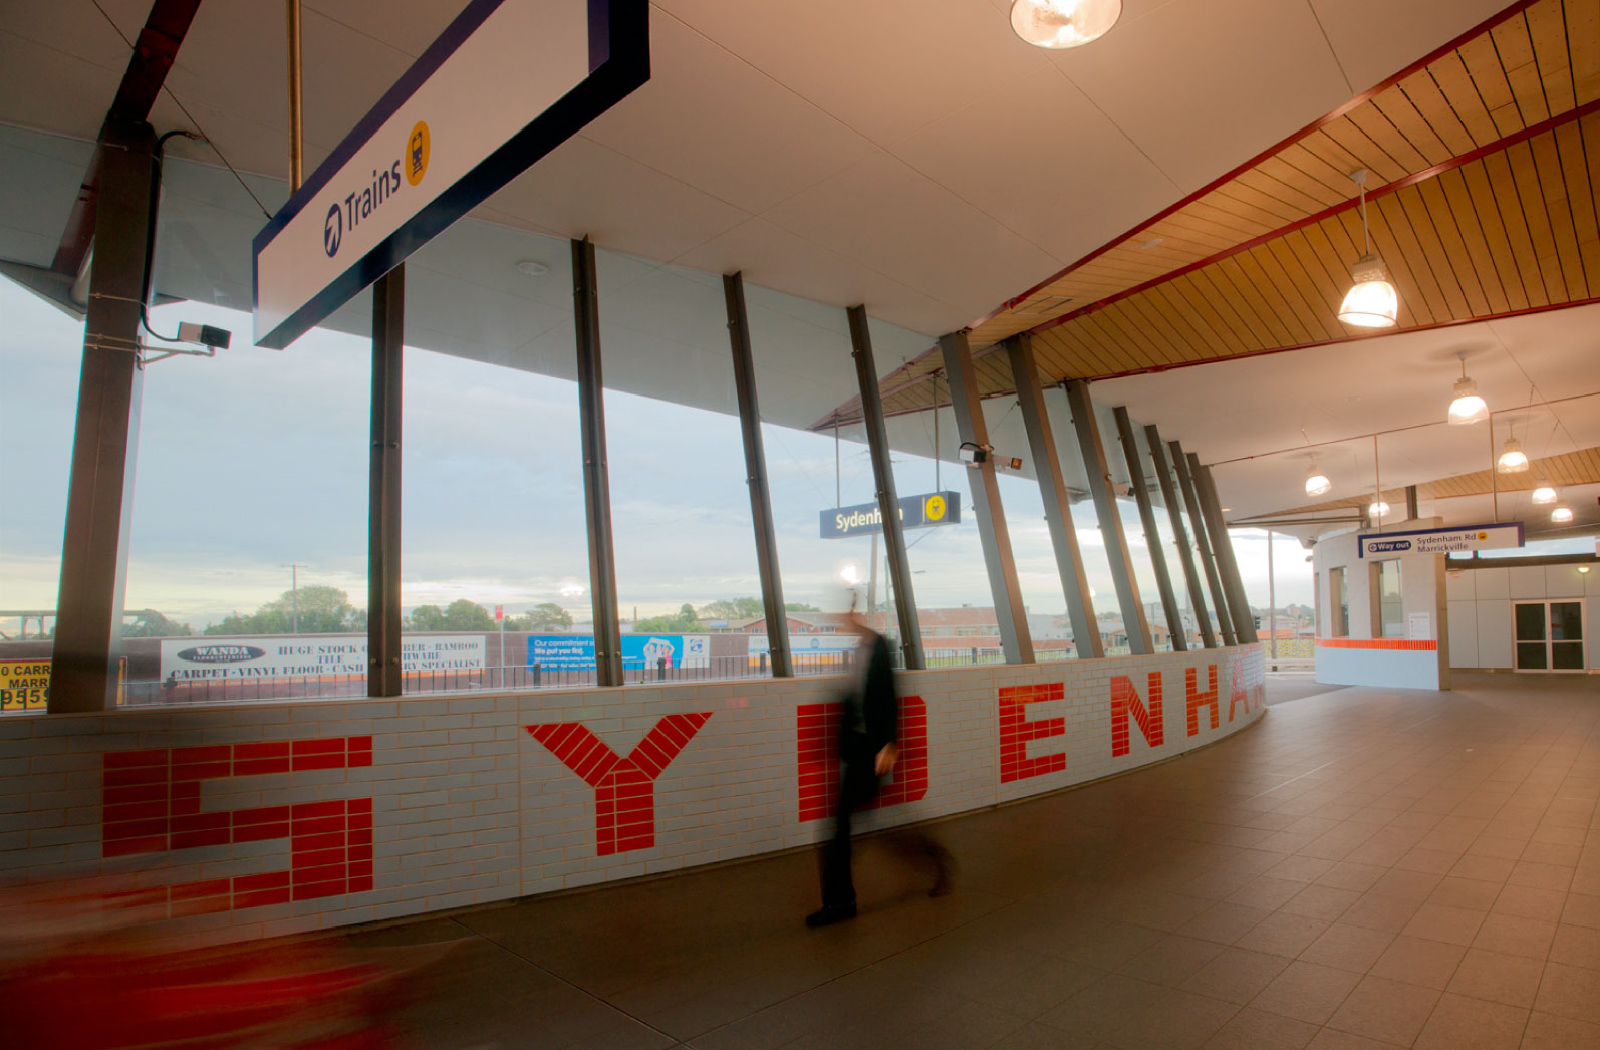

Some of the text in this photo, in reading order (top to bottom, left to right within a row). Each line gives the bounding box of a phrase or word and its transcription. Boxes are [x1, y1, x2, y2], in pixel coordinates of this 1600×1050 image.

[344, 159, 402, 232] Trains
[835, 507, 904, 532] Sydenh
[1416, 532, 1477, 545] Sydenham Rd
[1377, 541, 1410, 551] Way out
[1417, 543, 1469, 553] Marrickville
[195, 646, 249, 656] WANDA
[171, 668, 231, 679] CARPET
[238, 666, 279, 676] VINYL
[283, 664, 323, 675] FLOOR
[332, 663, 364, 673] CASH
